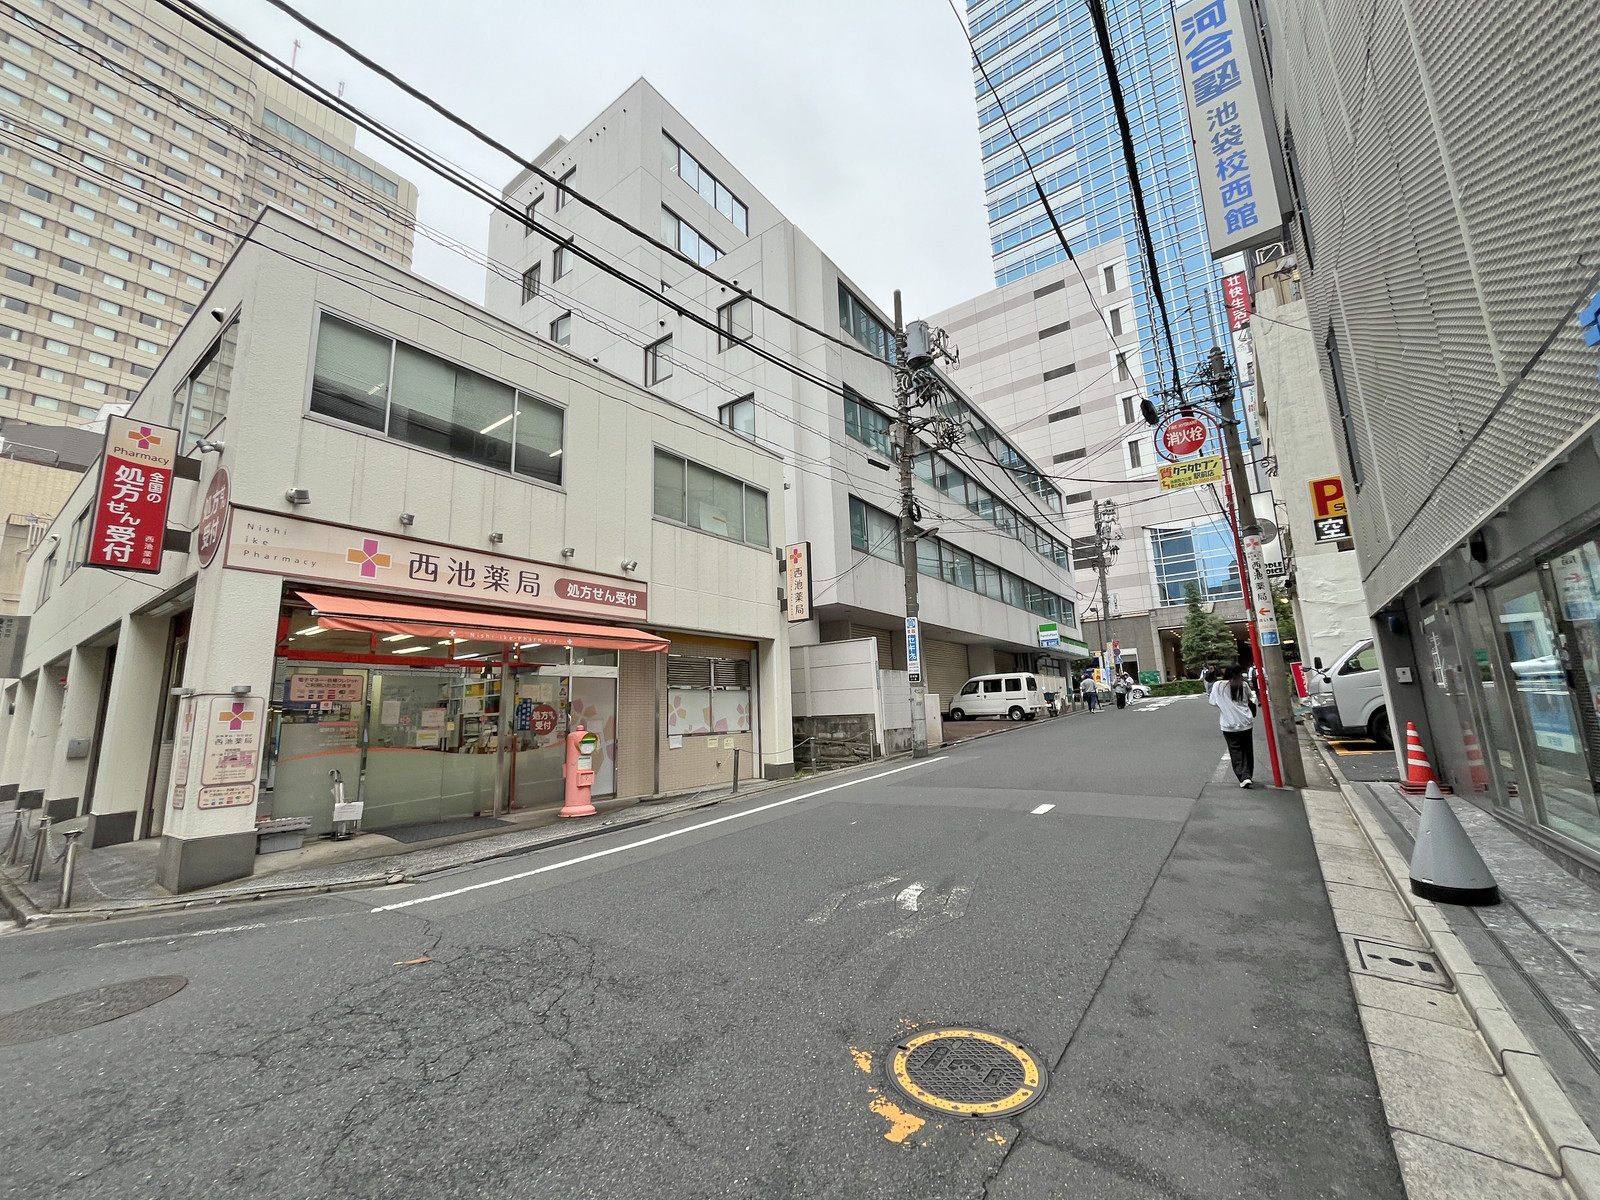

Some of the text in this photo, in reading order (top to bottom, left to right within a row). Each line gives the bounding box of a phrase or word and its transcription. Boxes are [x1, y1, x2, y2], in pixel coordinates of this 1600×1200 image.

[1166, 425, 1204, 448] 消火栓
[113, 445, 170, 467] Pharmacy
[146, 471, 166, 505] 全国の
[1313, 479, 1345, 517] P
[102, 464, 146, 564] 処方せん受付
[200, 515, 220, 551] 受付
[245, 535, 270, 547] ike
[246, 522, 288, 537] Nishi
[1317, 518, 1347, 540] 空
[141, 535, 155, 566] 西池薬局
[243, 549, 318, 568] Pharmacy
[408, 551, 638, 608] 西池薬局 処方せん受付
[793, 566, 804, 615] 西池薬局
[1251, 561, 1268, 601] 西池薬局
[535, 720, 552, 730] 受付
[214, 737, 253, 746] 西池薬局
